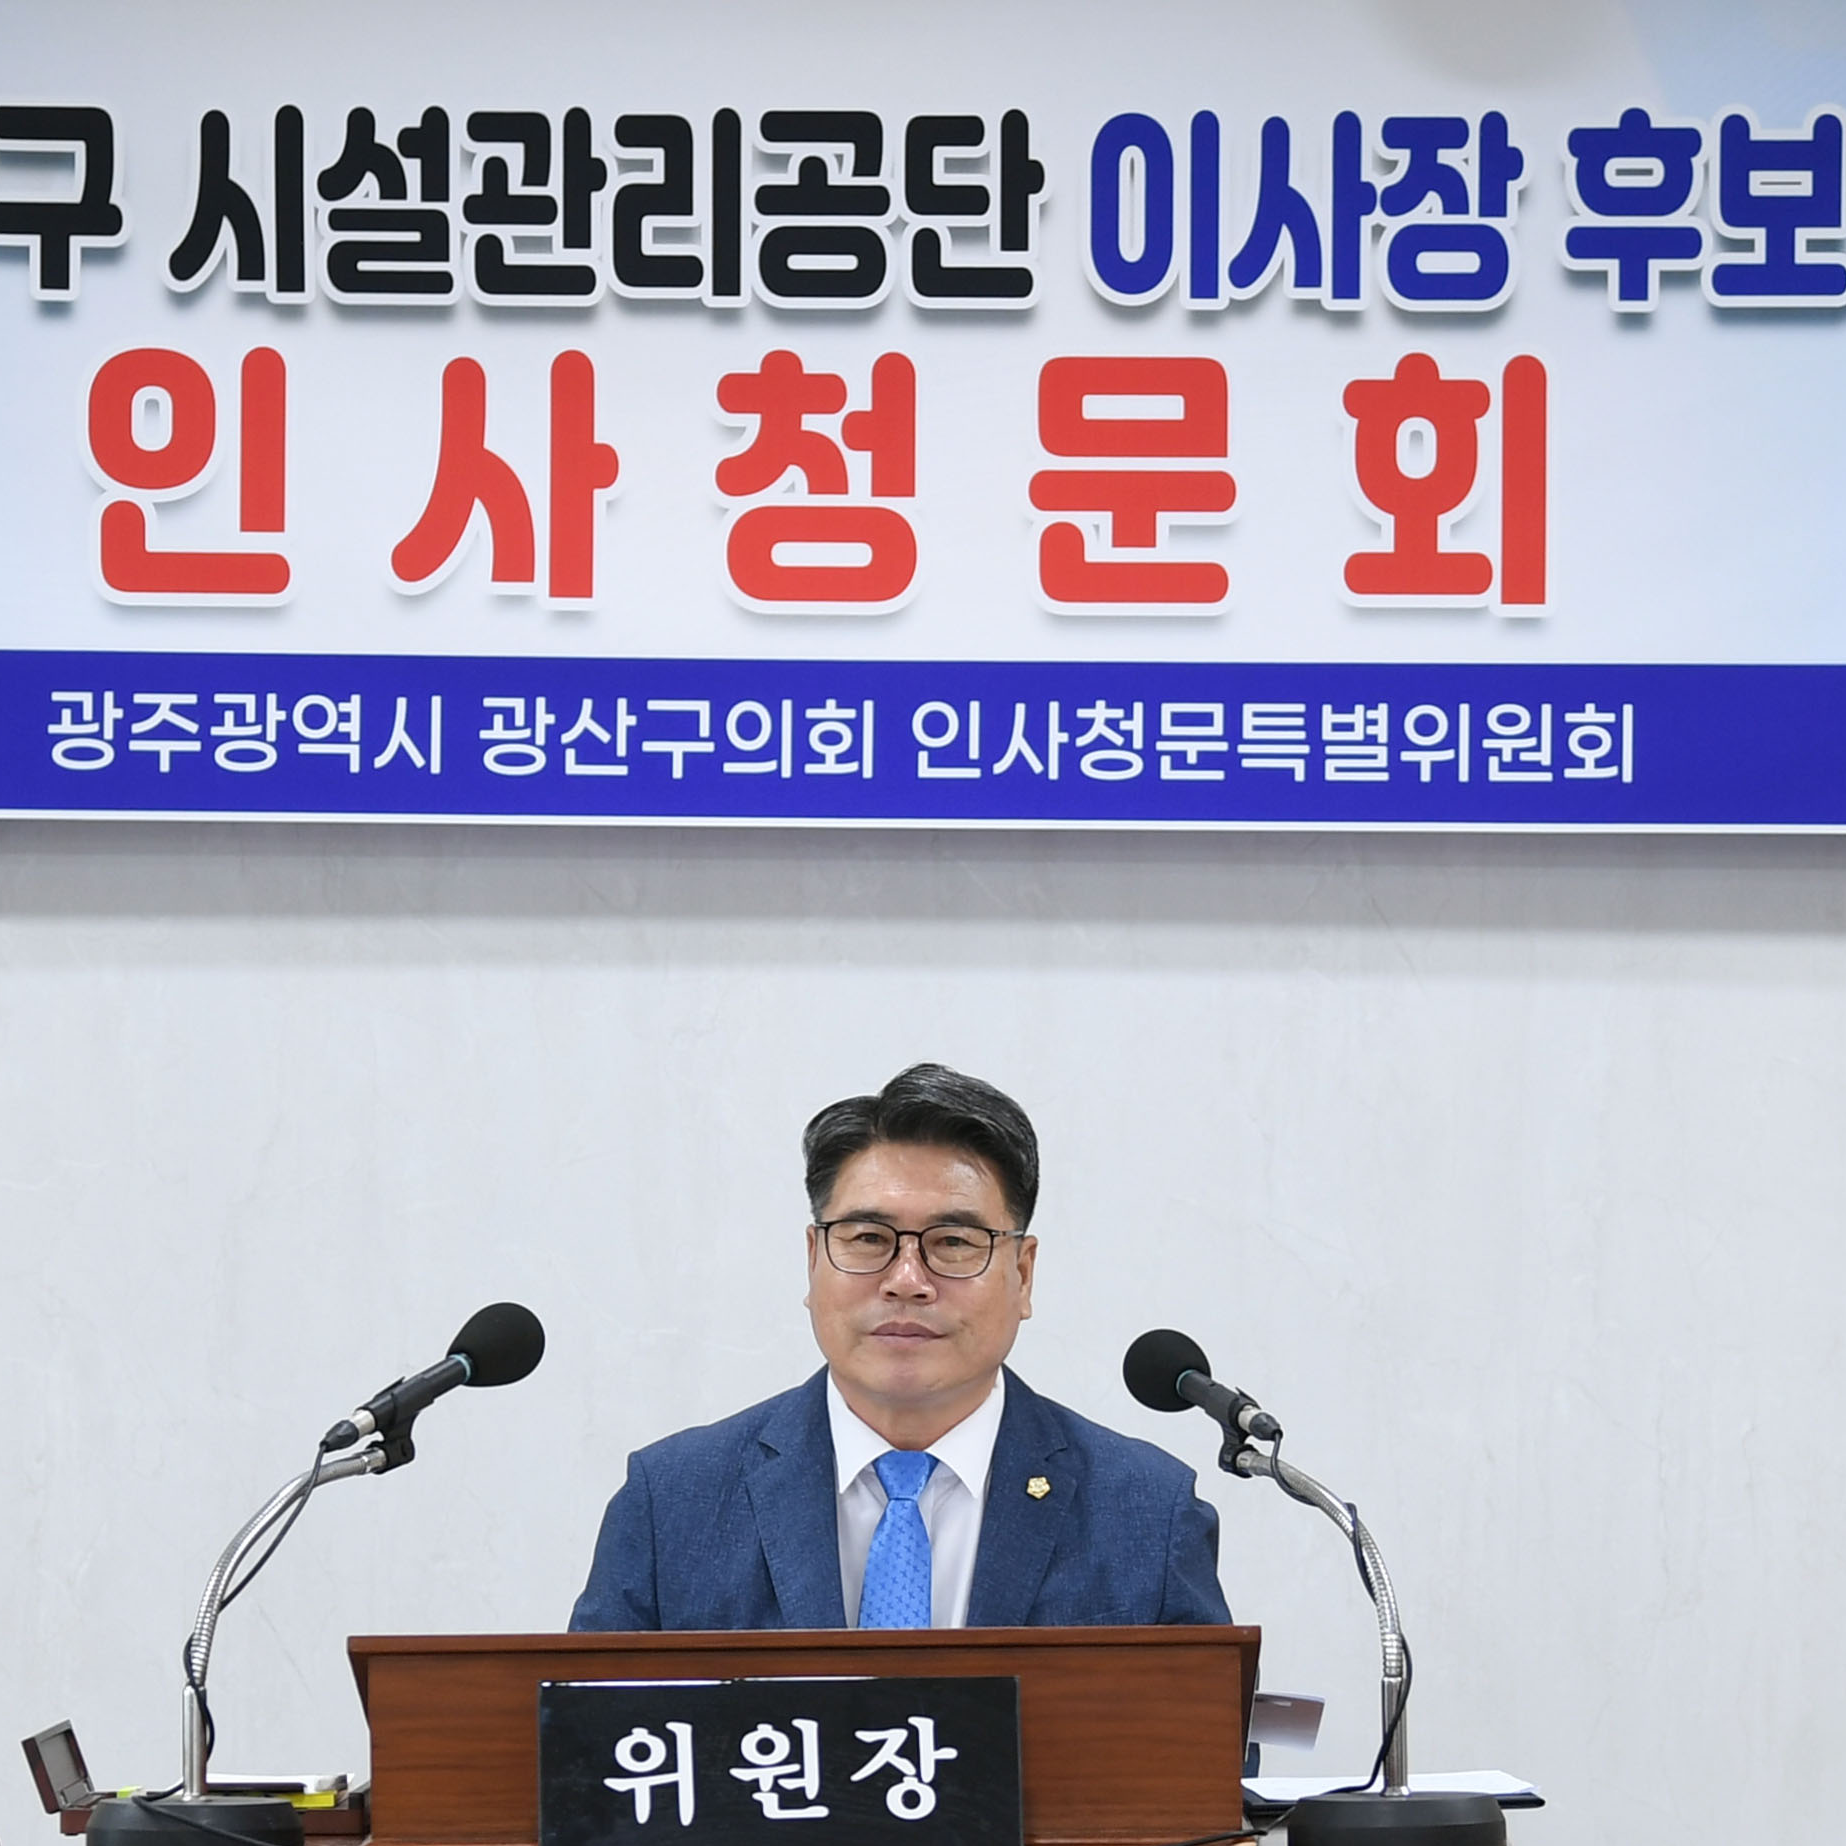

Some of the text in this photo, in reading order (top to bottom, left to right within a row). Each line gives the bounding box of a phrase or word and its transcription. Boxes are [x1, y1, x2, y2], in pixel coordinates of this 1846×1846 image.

[169, 104, 1045, 299] 시설관리공단
[1091, 109, 1524, 301] 이사장
[47, 691, 1634, 784] 광주광역시 광산구의회 인사청문특별위원회
[603, 1716, 958, 1826] 위원장
